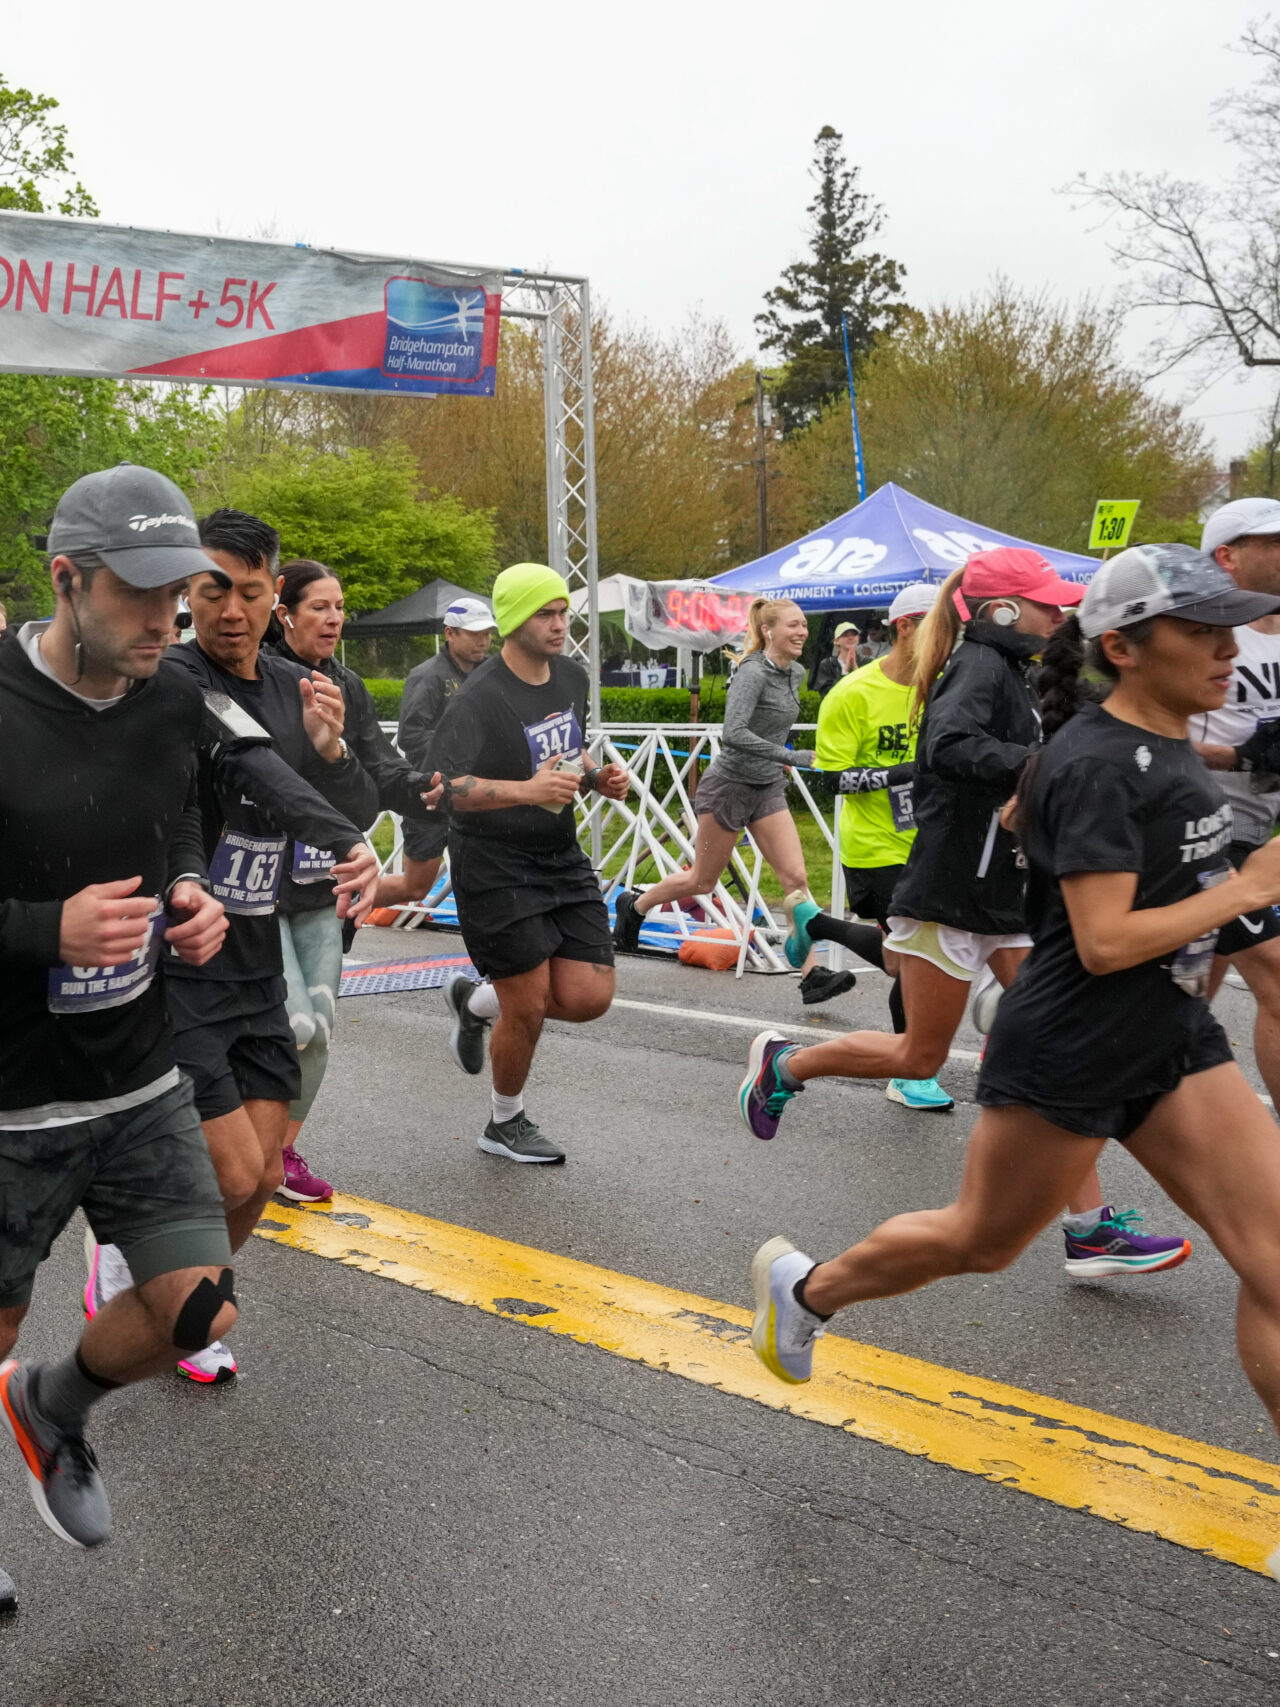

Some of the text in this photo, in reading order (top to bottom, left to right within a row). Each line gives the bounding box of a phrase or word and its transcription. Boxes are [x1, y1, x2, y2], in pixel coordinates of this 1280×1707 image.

[62, 262, 185, 322] HALF
[188, 289, 210, 319] +
[215, 277, 278, 330] 5K
[389, 336, 474, 358] Bridgehampton
[387, 354, 456, 373] Half-Marathon
[1099, 516, 1126, 541] 1:30
[536, 723, 572, 761] 347
[839, 768, 889, 792] BEAST
[223, 849, 279, 891] 163
[299, 860, 311, 868] RUN
[312, 860, 321, 868] THE
[231, 888, 246, 901] THE
[61, 982, 86, 995] RUN
[88, 980, 106, 994] THE
